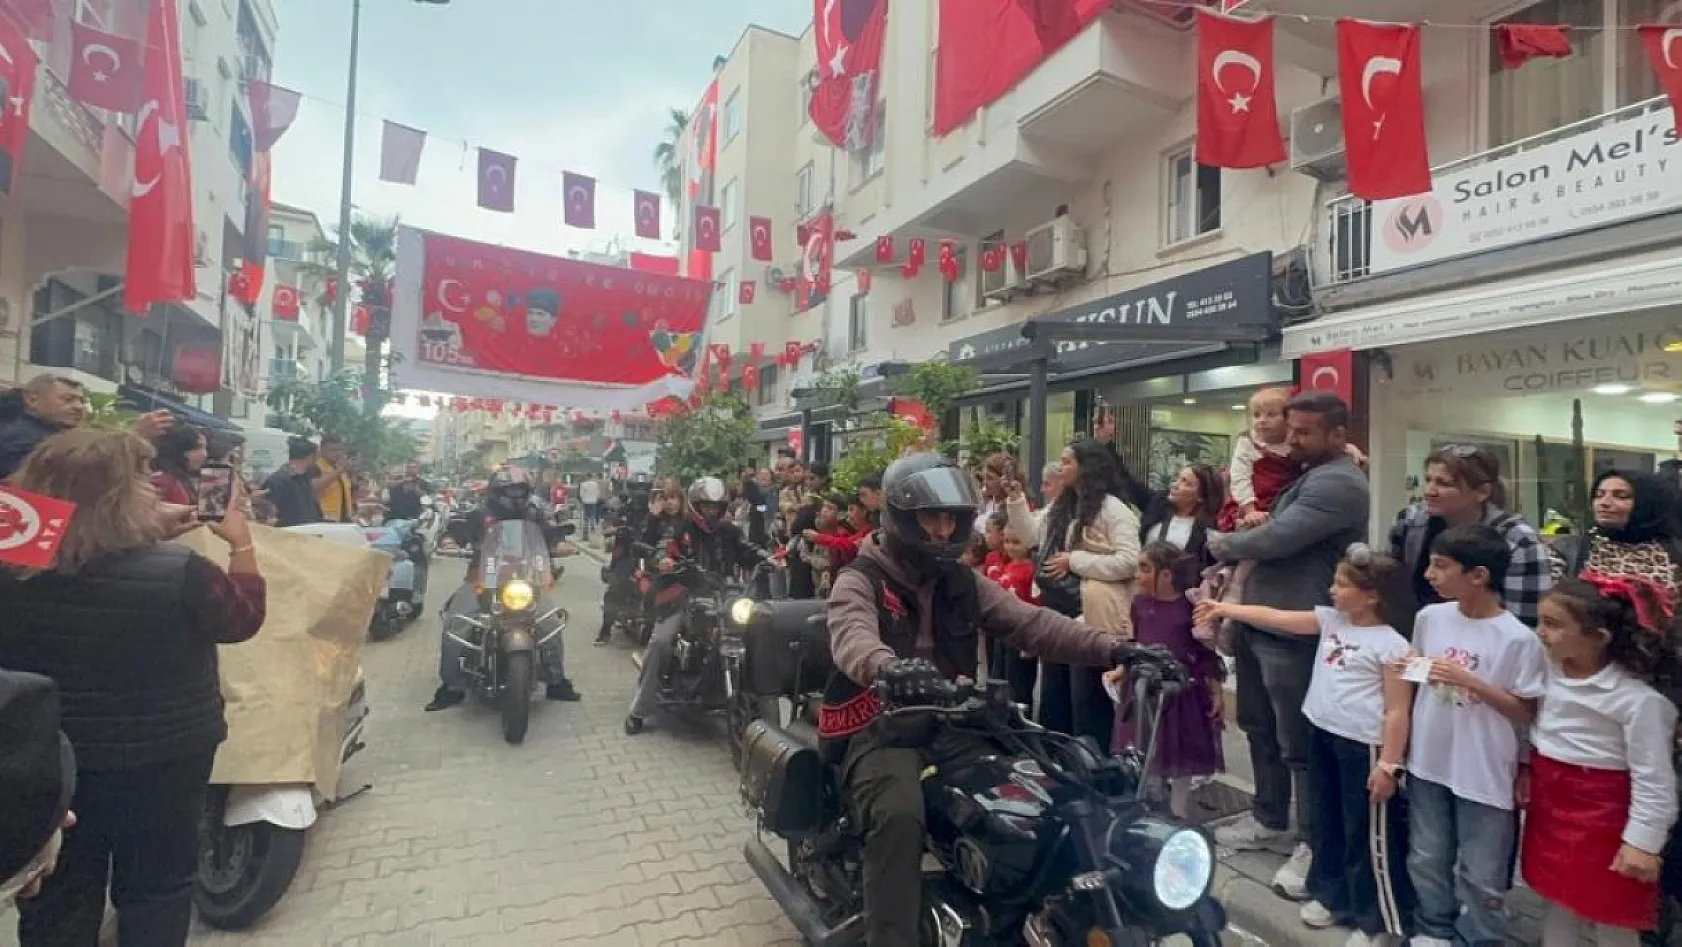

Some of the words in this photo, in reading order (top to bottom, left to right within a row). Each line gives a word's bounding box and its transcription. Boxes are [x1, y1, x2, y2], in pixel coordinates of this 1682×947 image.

[1454, 164, 1549, 203] Salon
[1566, 124, 1680, 172] Mel's
[1461, 198, 1517, 221] HAIR
[1556, 158, 1668, 198] BEAUTY
[1457, 344, 1548, 375] BAYAN
[1503, 361, 1670, 390] COIFFEUR
